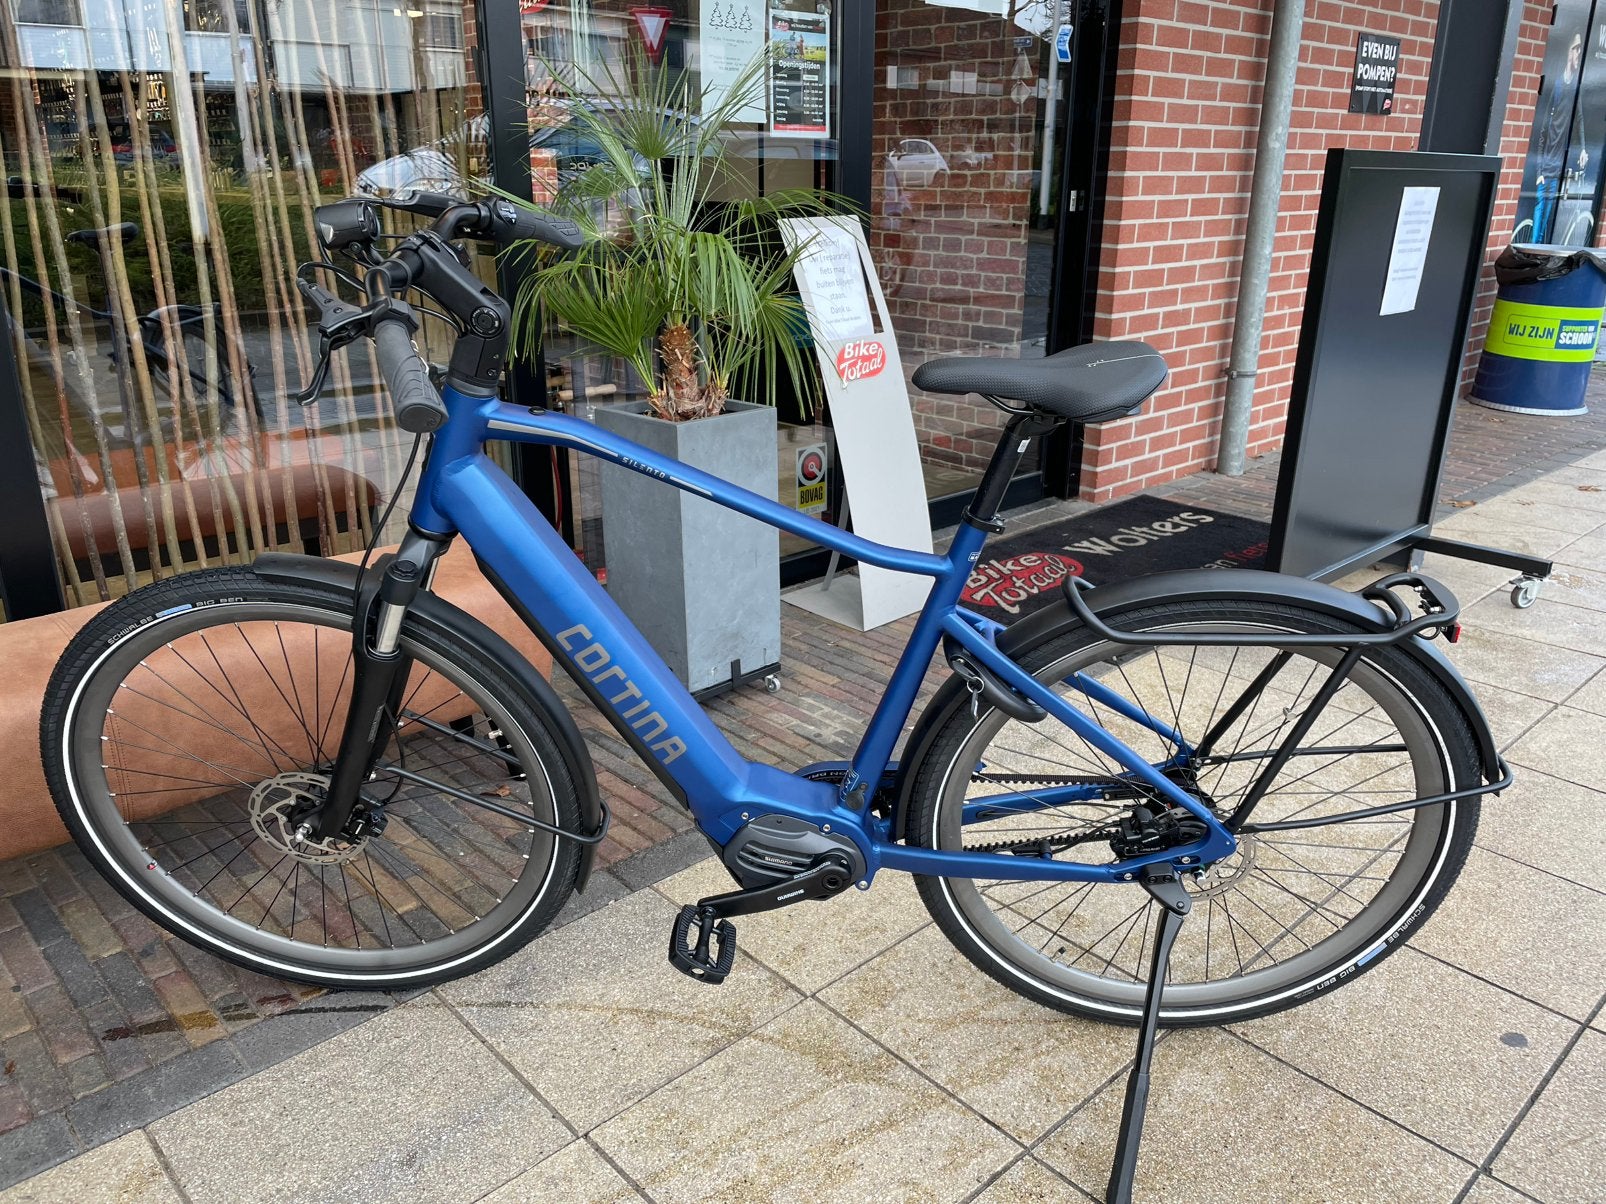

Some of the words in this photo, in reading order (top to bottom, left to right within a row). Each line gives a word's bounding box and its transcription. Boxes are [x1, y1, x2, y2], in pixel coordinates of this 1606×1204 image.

[1362, 41, 1384, 59] EVEN
[1384, 45, 1397, 60] BIJ
[778, 60, 820, 70] Openingstijden
[1357, 64, 1396, 82] POMPEN?
[1508, 323, 1526, 336] WIJ
[1528, 326, 1555, 339] ZIJN
[1559, 332, 1593, 344] SCHOON
[844, 340, 878, 358] Bike
[840, 348, 882, 388] Totaal
[622, 456, 666, 479] SILENTO
[800, 486, 824, 505] BOVAG
[1062, 512, 1214, 556] Wolters
[966, 556, 1042, 588] Bike
[971, 555, 1076, 614] Totaal
[107, 616, 153, 645] SCHWALBE
[556, 624, 687, 765] CORTINA
[765, 856, 792, 865] SHIMANO
[1387, 903, 1426, 943] SCHWALBE
[1340, 965, 1356, 978] BIG
[1317, 977, 1336, 990] BEN
